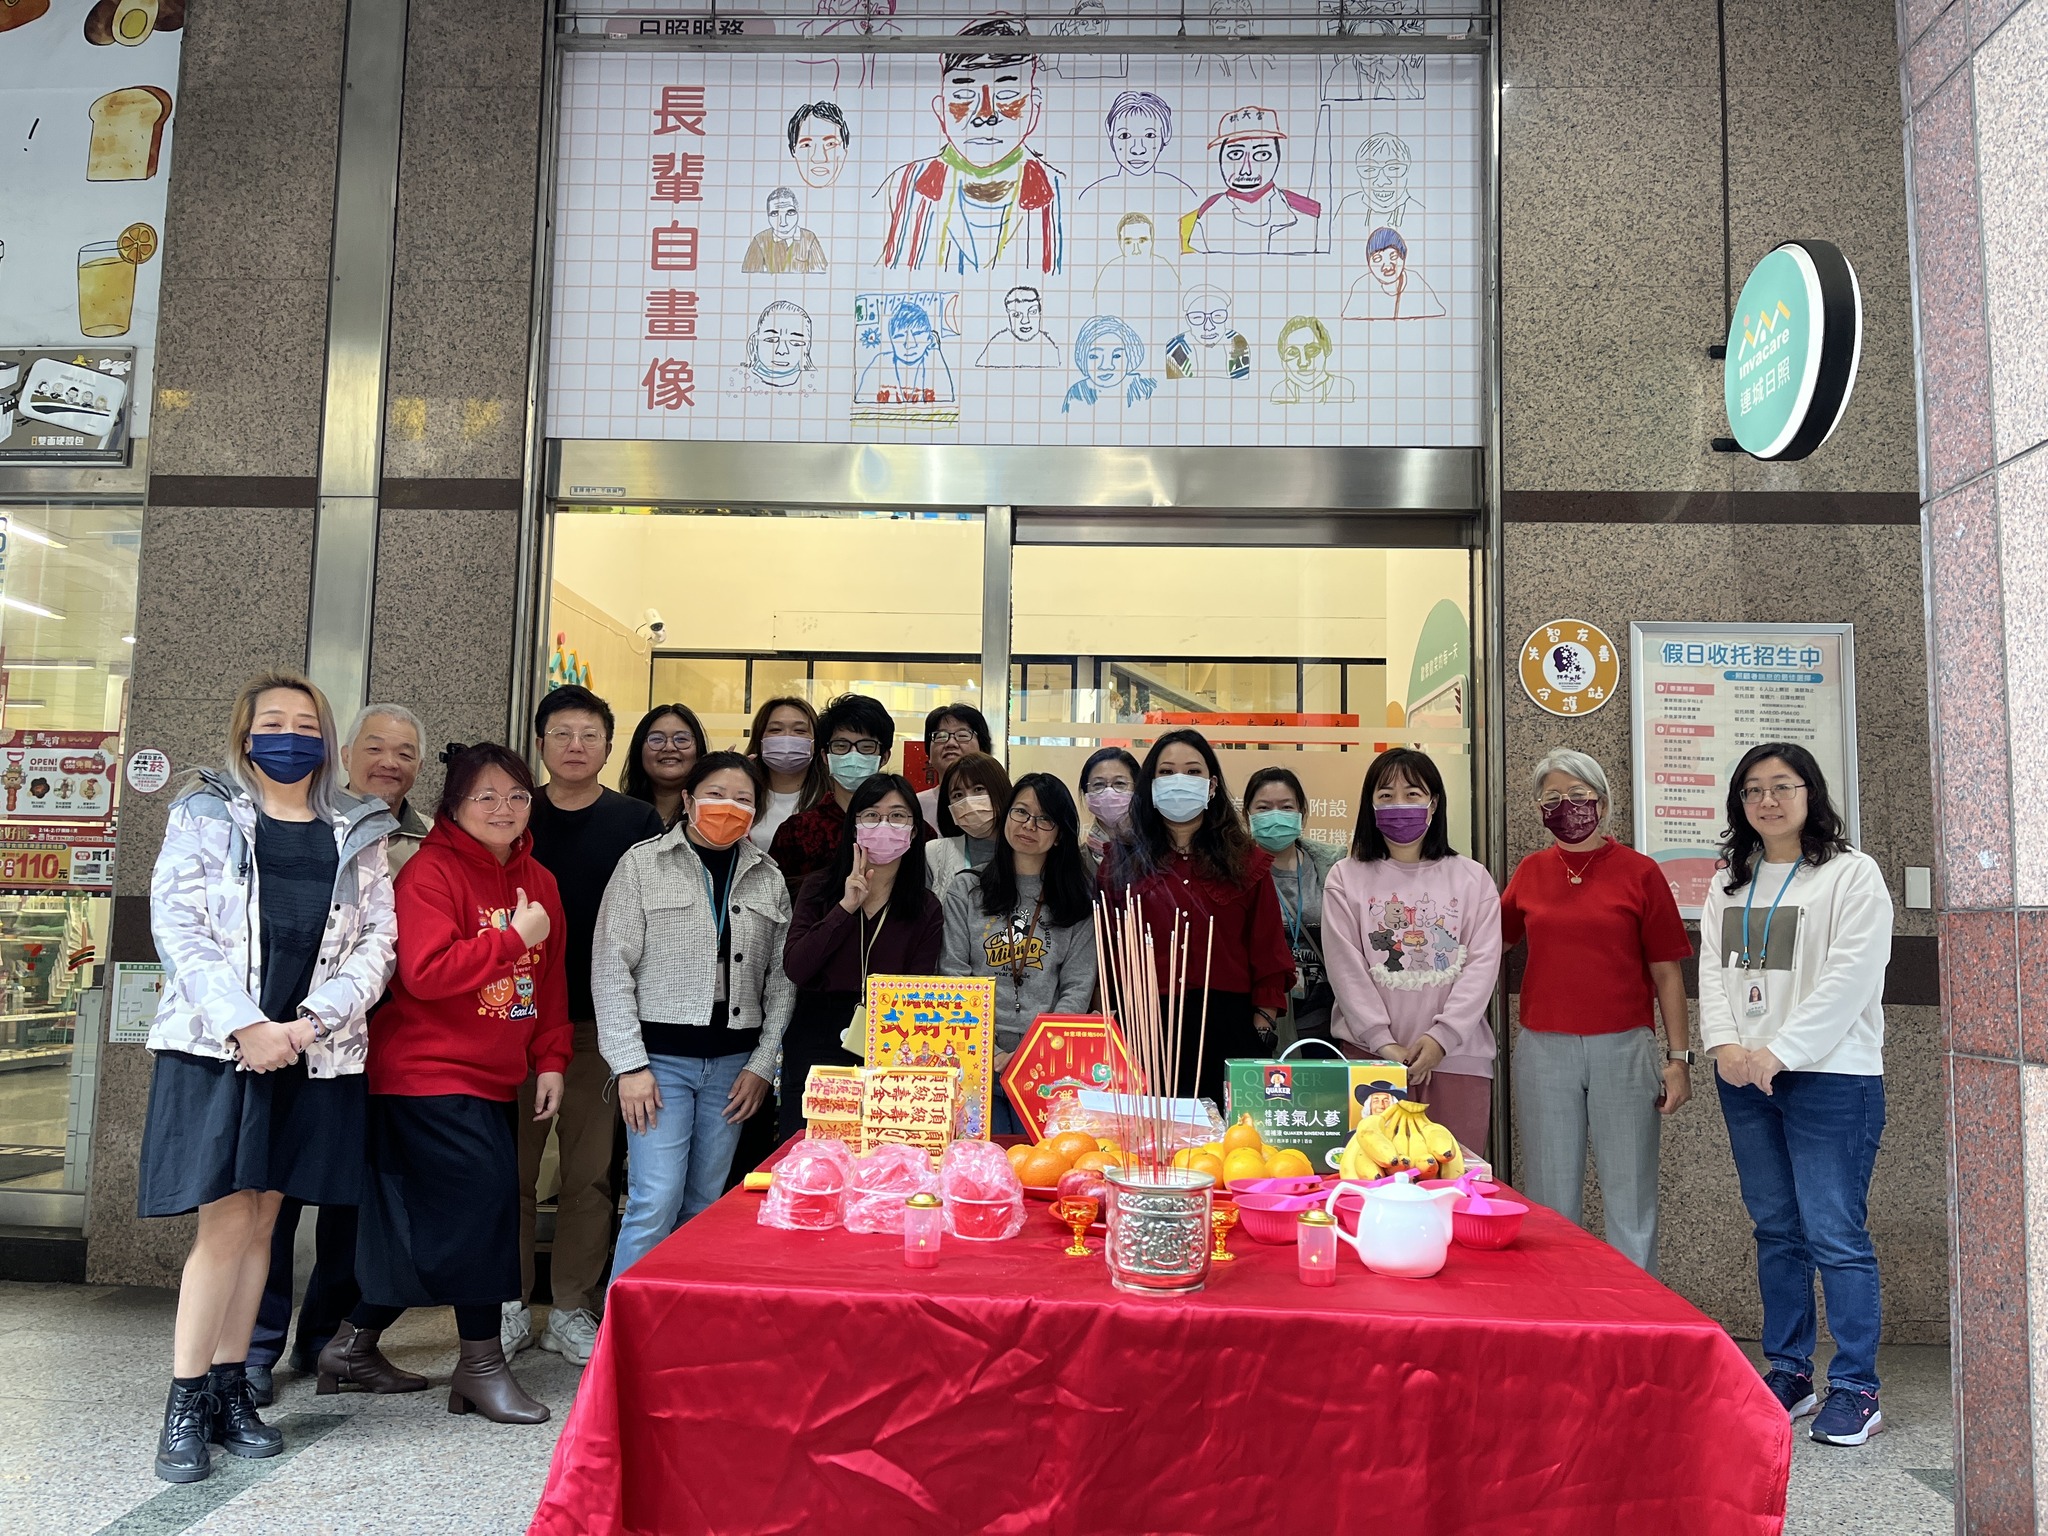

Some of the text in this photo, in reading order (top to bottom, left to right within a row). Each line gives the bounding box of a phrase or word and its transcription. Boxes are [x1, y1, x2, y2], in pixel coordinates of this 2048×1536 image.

[642, 85, 707, 411] 長輩自畫像
[1739, 327, 1790, 381] invacare
[1740, 358, 1790, 417] 連城日照
[1662, 643, 1820, 668] 假日收托招生中
[30, 758, 58, 766] OPEN!
[1309, 799, 1348, 818] 附設
[880, 1008, 980, 1040] 武財神
[870, 1085, 949, 1104] 頂級壽金
[1265, 1087, 1291, 1095] QUAKER
[870, 1106, 948, 1125] 頂級壽金
[1264, 1109, 1341, 1127] 桂格 養氣人蔘
